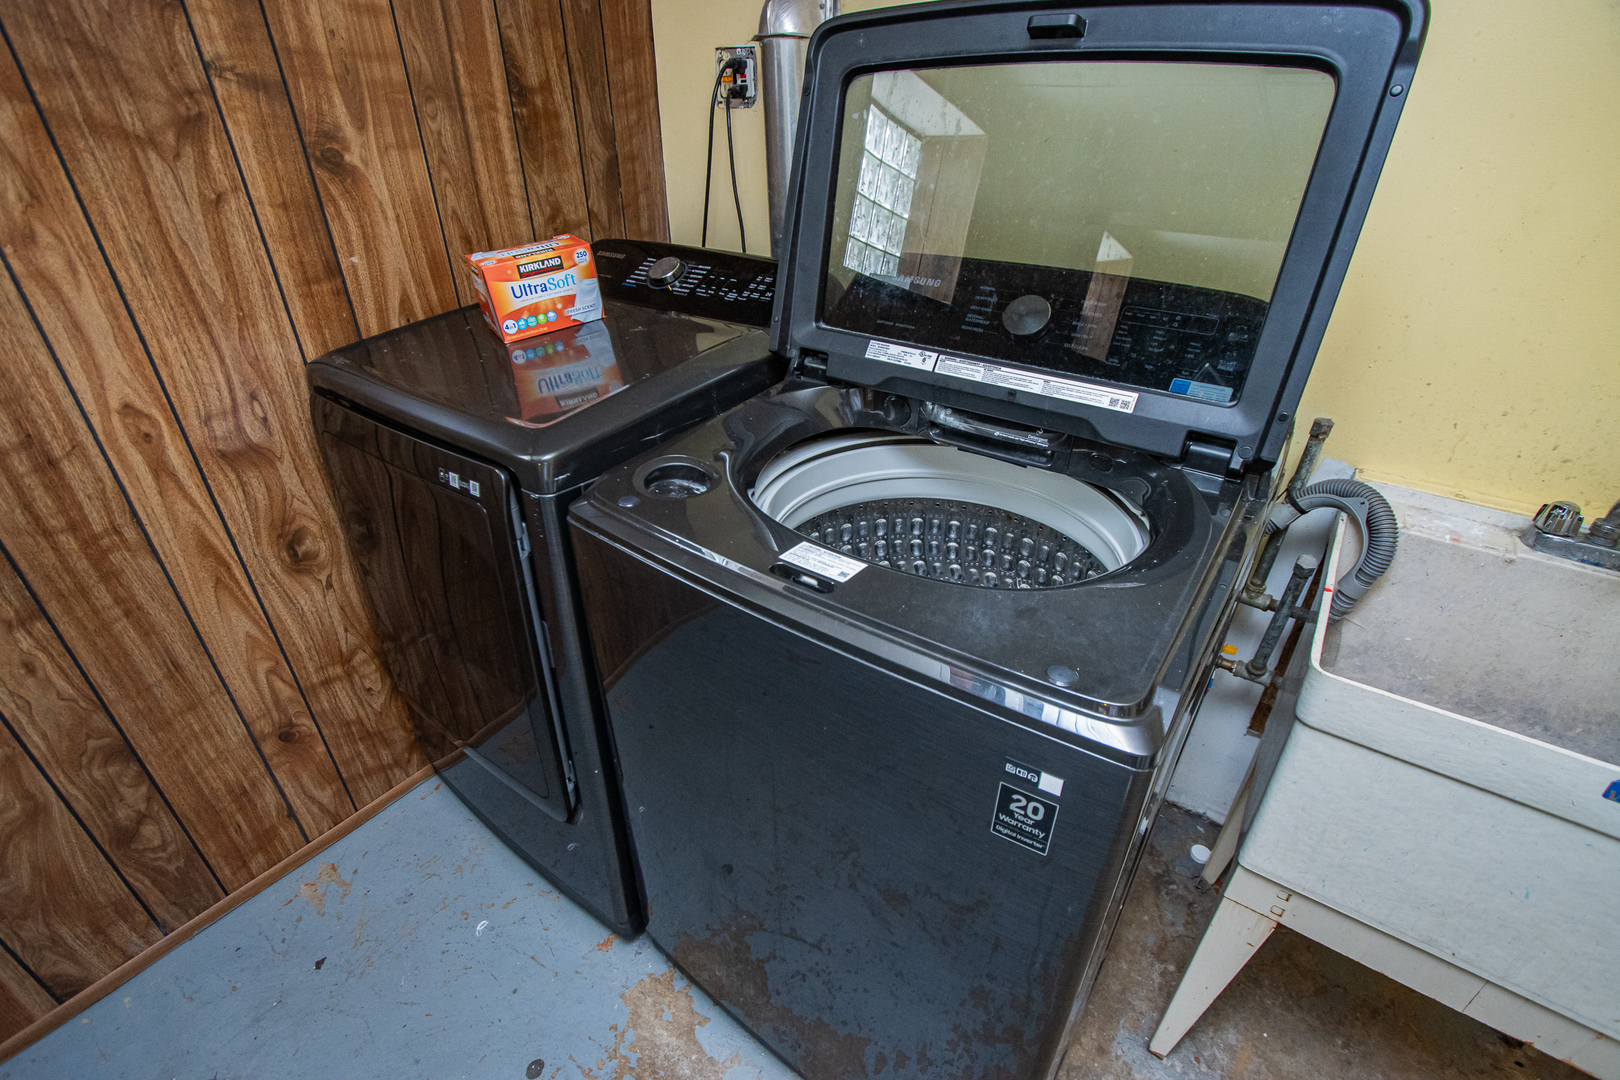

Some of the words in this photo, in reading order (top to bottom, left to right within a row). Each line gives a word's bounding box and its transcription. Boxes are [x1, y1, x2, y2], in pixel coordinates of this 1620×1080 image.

[576, 250, 588, 259] 250
[519, 257, 561, 273] KIRKLAND
[511, 273, 577, 299] UltraSoft
[892, 274, 942, 288] SAMSUNG
[567, 307, 581, 315] FRESH
[582, 303, 596, 312] SCENT
[1009, 794, 1045, 821] 20
[998, 812, 1046, 839] Warranty
[1013, 812, 1036, 826] Year
[995, 824, 1017, 838] Digital
[1016, 833, 1044, 849] Inverter
